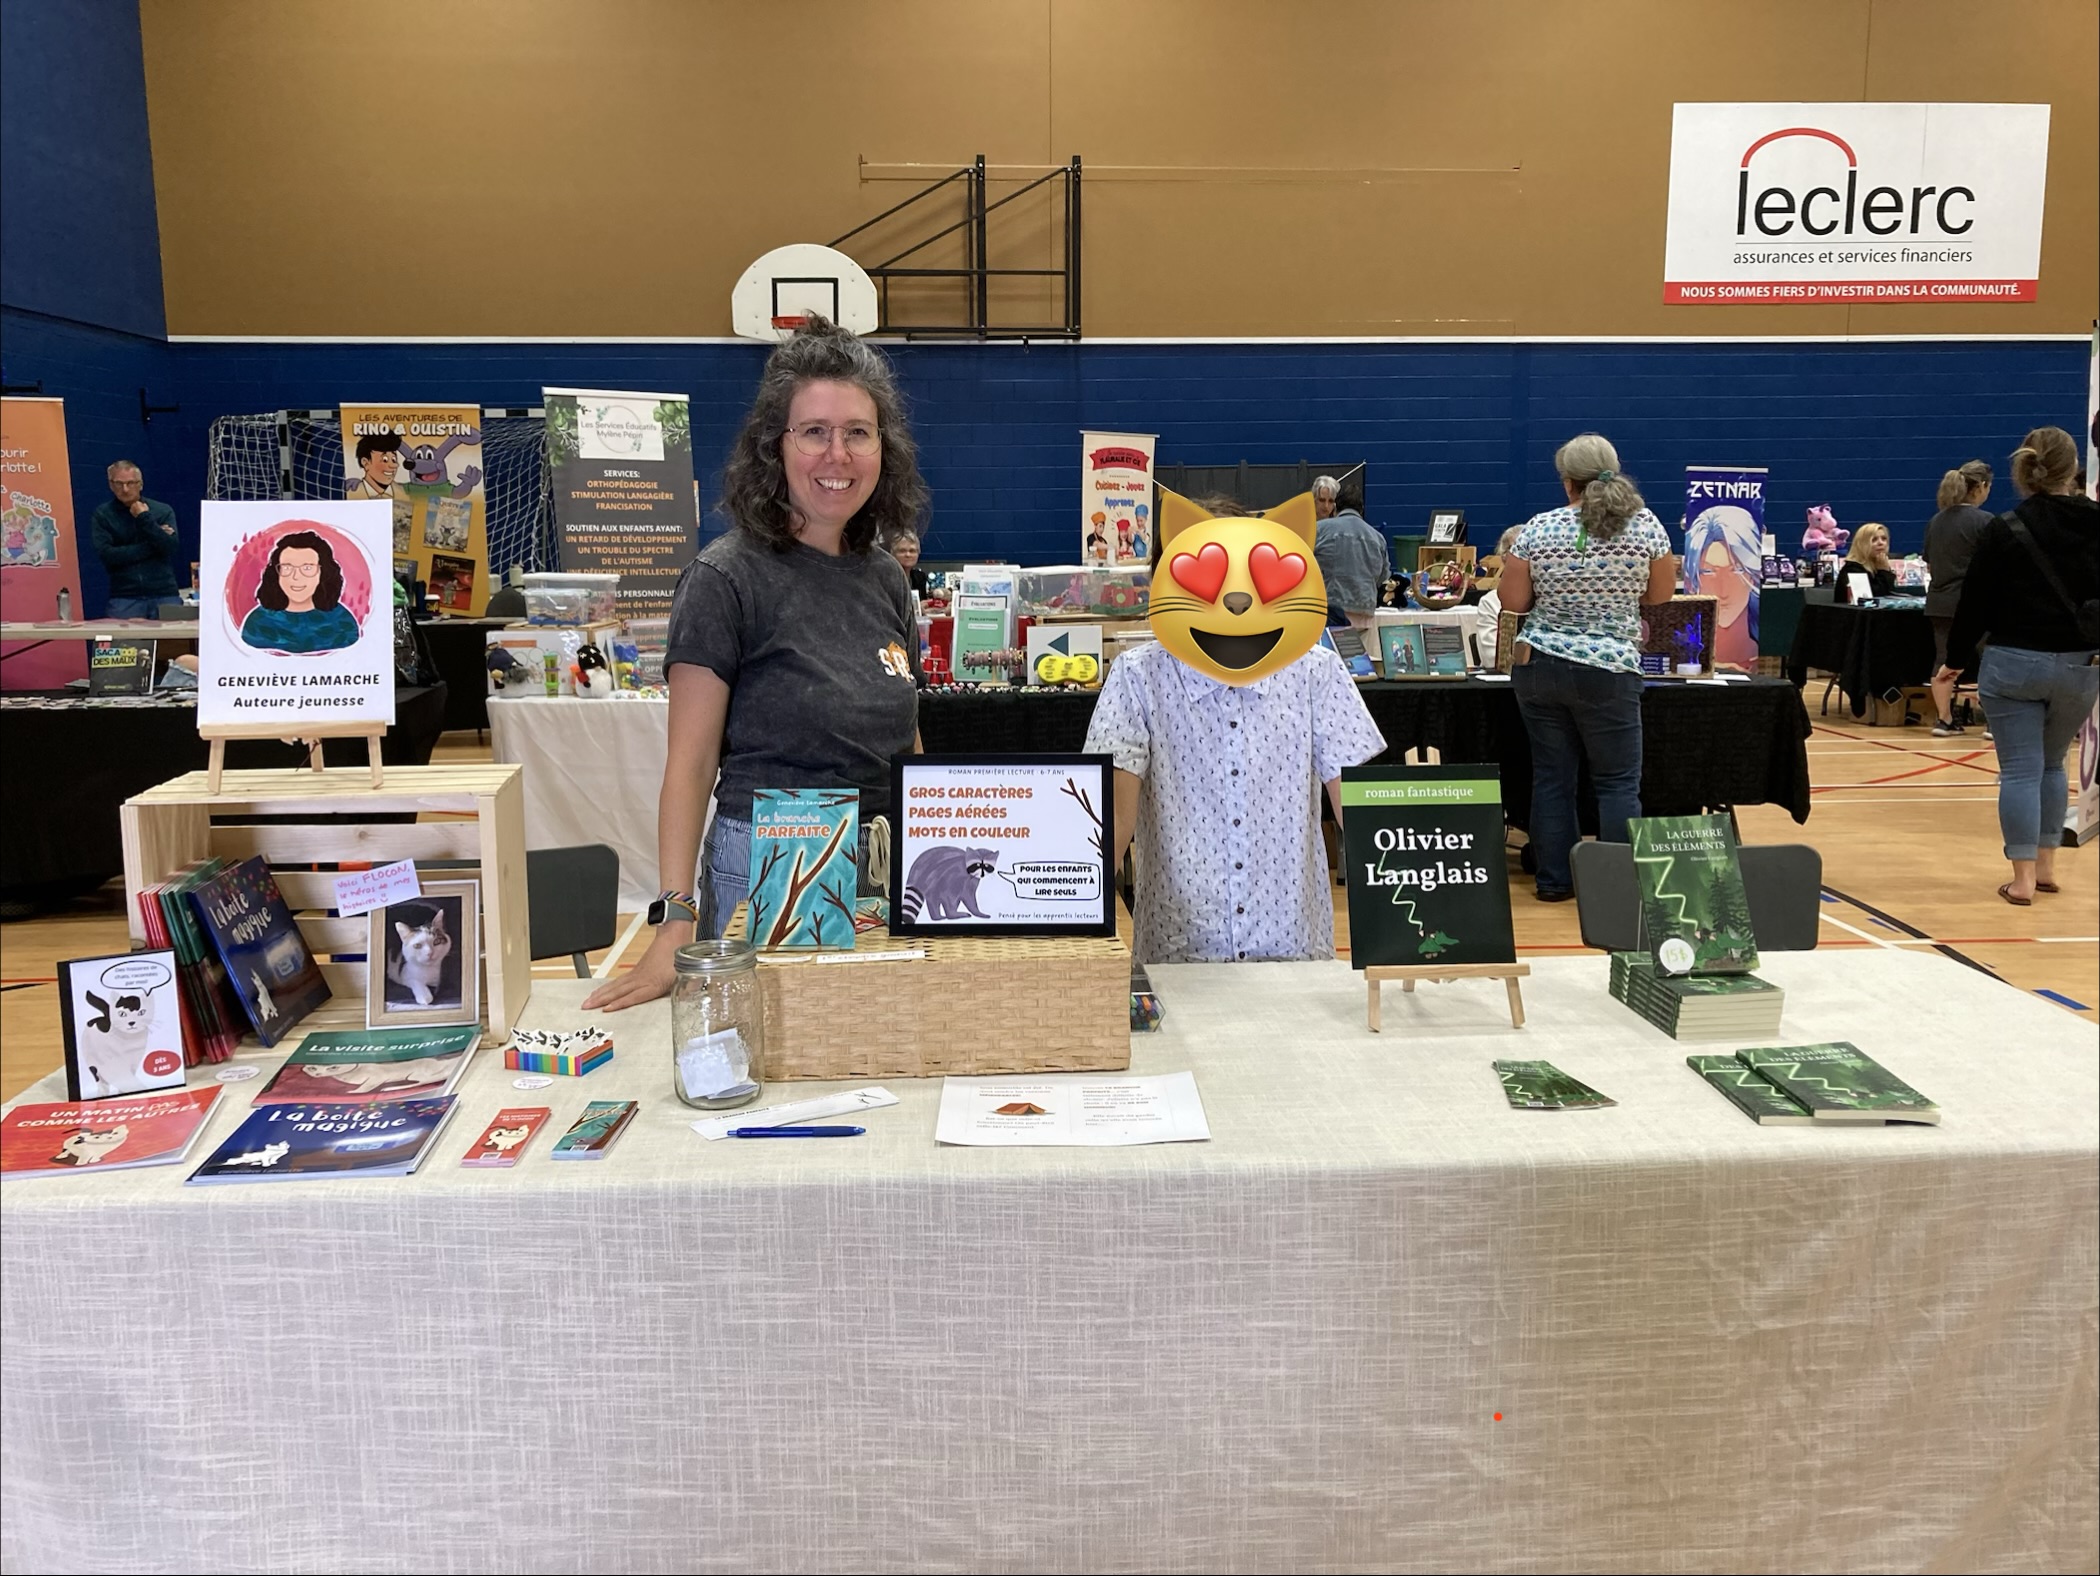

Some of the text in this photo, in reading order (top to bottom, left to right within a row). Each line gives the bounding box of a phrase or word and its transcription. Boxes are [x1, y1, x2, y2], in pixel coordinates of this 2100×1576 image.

[1737, 171, 1976, 236] leclerc
[1733, 247, 1972, 265] assurances et services financiers
[1680, 282, 2021, 298] NOUS SOMMES FIERS D'INVESTIR DANS LA COMMUNAUTÉ.
[358, 414, 462, 422] LES AVENTURES DE
[353, 423, 471, 436] RINO & OUISTIN
[580, 421, 657, 431] Les Services Éducatifs
[603, 470, 641, 478] SERVICES:
[586, 480, 658, 489] ORTHOPÉDAGOGIE
[1690, 481, 1762, 499] ZETNAR
[571, 491, 675, 500] STIMULATION LANGAGIÈRE
[595, 502, 653, 510] FRANCISATION
[565, 524, 599, 532] SOUTIEN
[600, 524, 618, 532] AUX
[565, 534, 687, 543] UN RETARD DE DÉVELOPPEMENT
[577, 546, 591, 554] UN
[592, 546, 628, 554] TROUBLE
[629, 546, 641, 554] DU
[93, 656, 135, 666] DES MAUX
[217, 673, 380, 687] GENEVIÈVE LAMARCHE
[233, 696, 364, 709] Auteure jeunesse
[908, 784, 1033, 799] GROS CARACTÈRES
[1365, 785, 1474, 801] roman fantastique
[757, 811, 821, 823] La branche
[908, 806, 952, 819] PAGES
[908, 826, 946, 838] MOTS
[970, 826, 1031, 838] COULEUR
[1666, 828, 1723, 839] LA GUERRE
[1374, 827, 1474, 851] Olivier
[1651, 840, 1726, 852] DES ÉLÉMENTS
[1019, 865, 1041, 873] POUR
[1042, 865, 1056, 873] LES
[1016, 877, 1031, 885] QUI
[1089, 875, 1095, 885] À
[1365, 861, 1488, 892] Langlais
[337, 878, 358, 888] Voici
[1035, 888, 1077, 896] LIRE SEULS
[342, 898, 376, 910] histoires
[1043, 912, 1073, 920] apprentis
[231, 906, 272, 945] magique
[309, 1034, 466, 1052] La visite surprise
[1799, 1047, 1849, 1056] GUERRE
[158, 1064, 171, 1072] ANS
[17, 1102, 201, 1128] COMME LES AUTRES
[50, 1101, 180, 1118] UN MATIN PAS
[268, 1110, 304, 1121] La
[291, 1117, 408, 1133] magique
